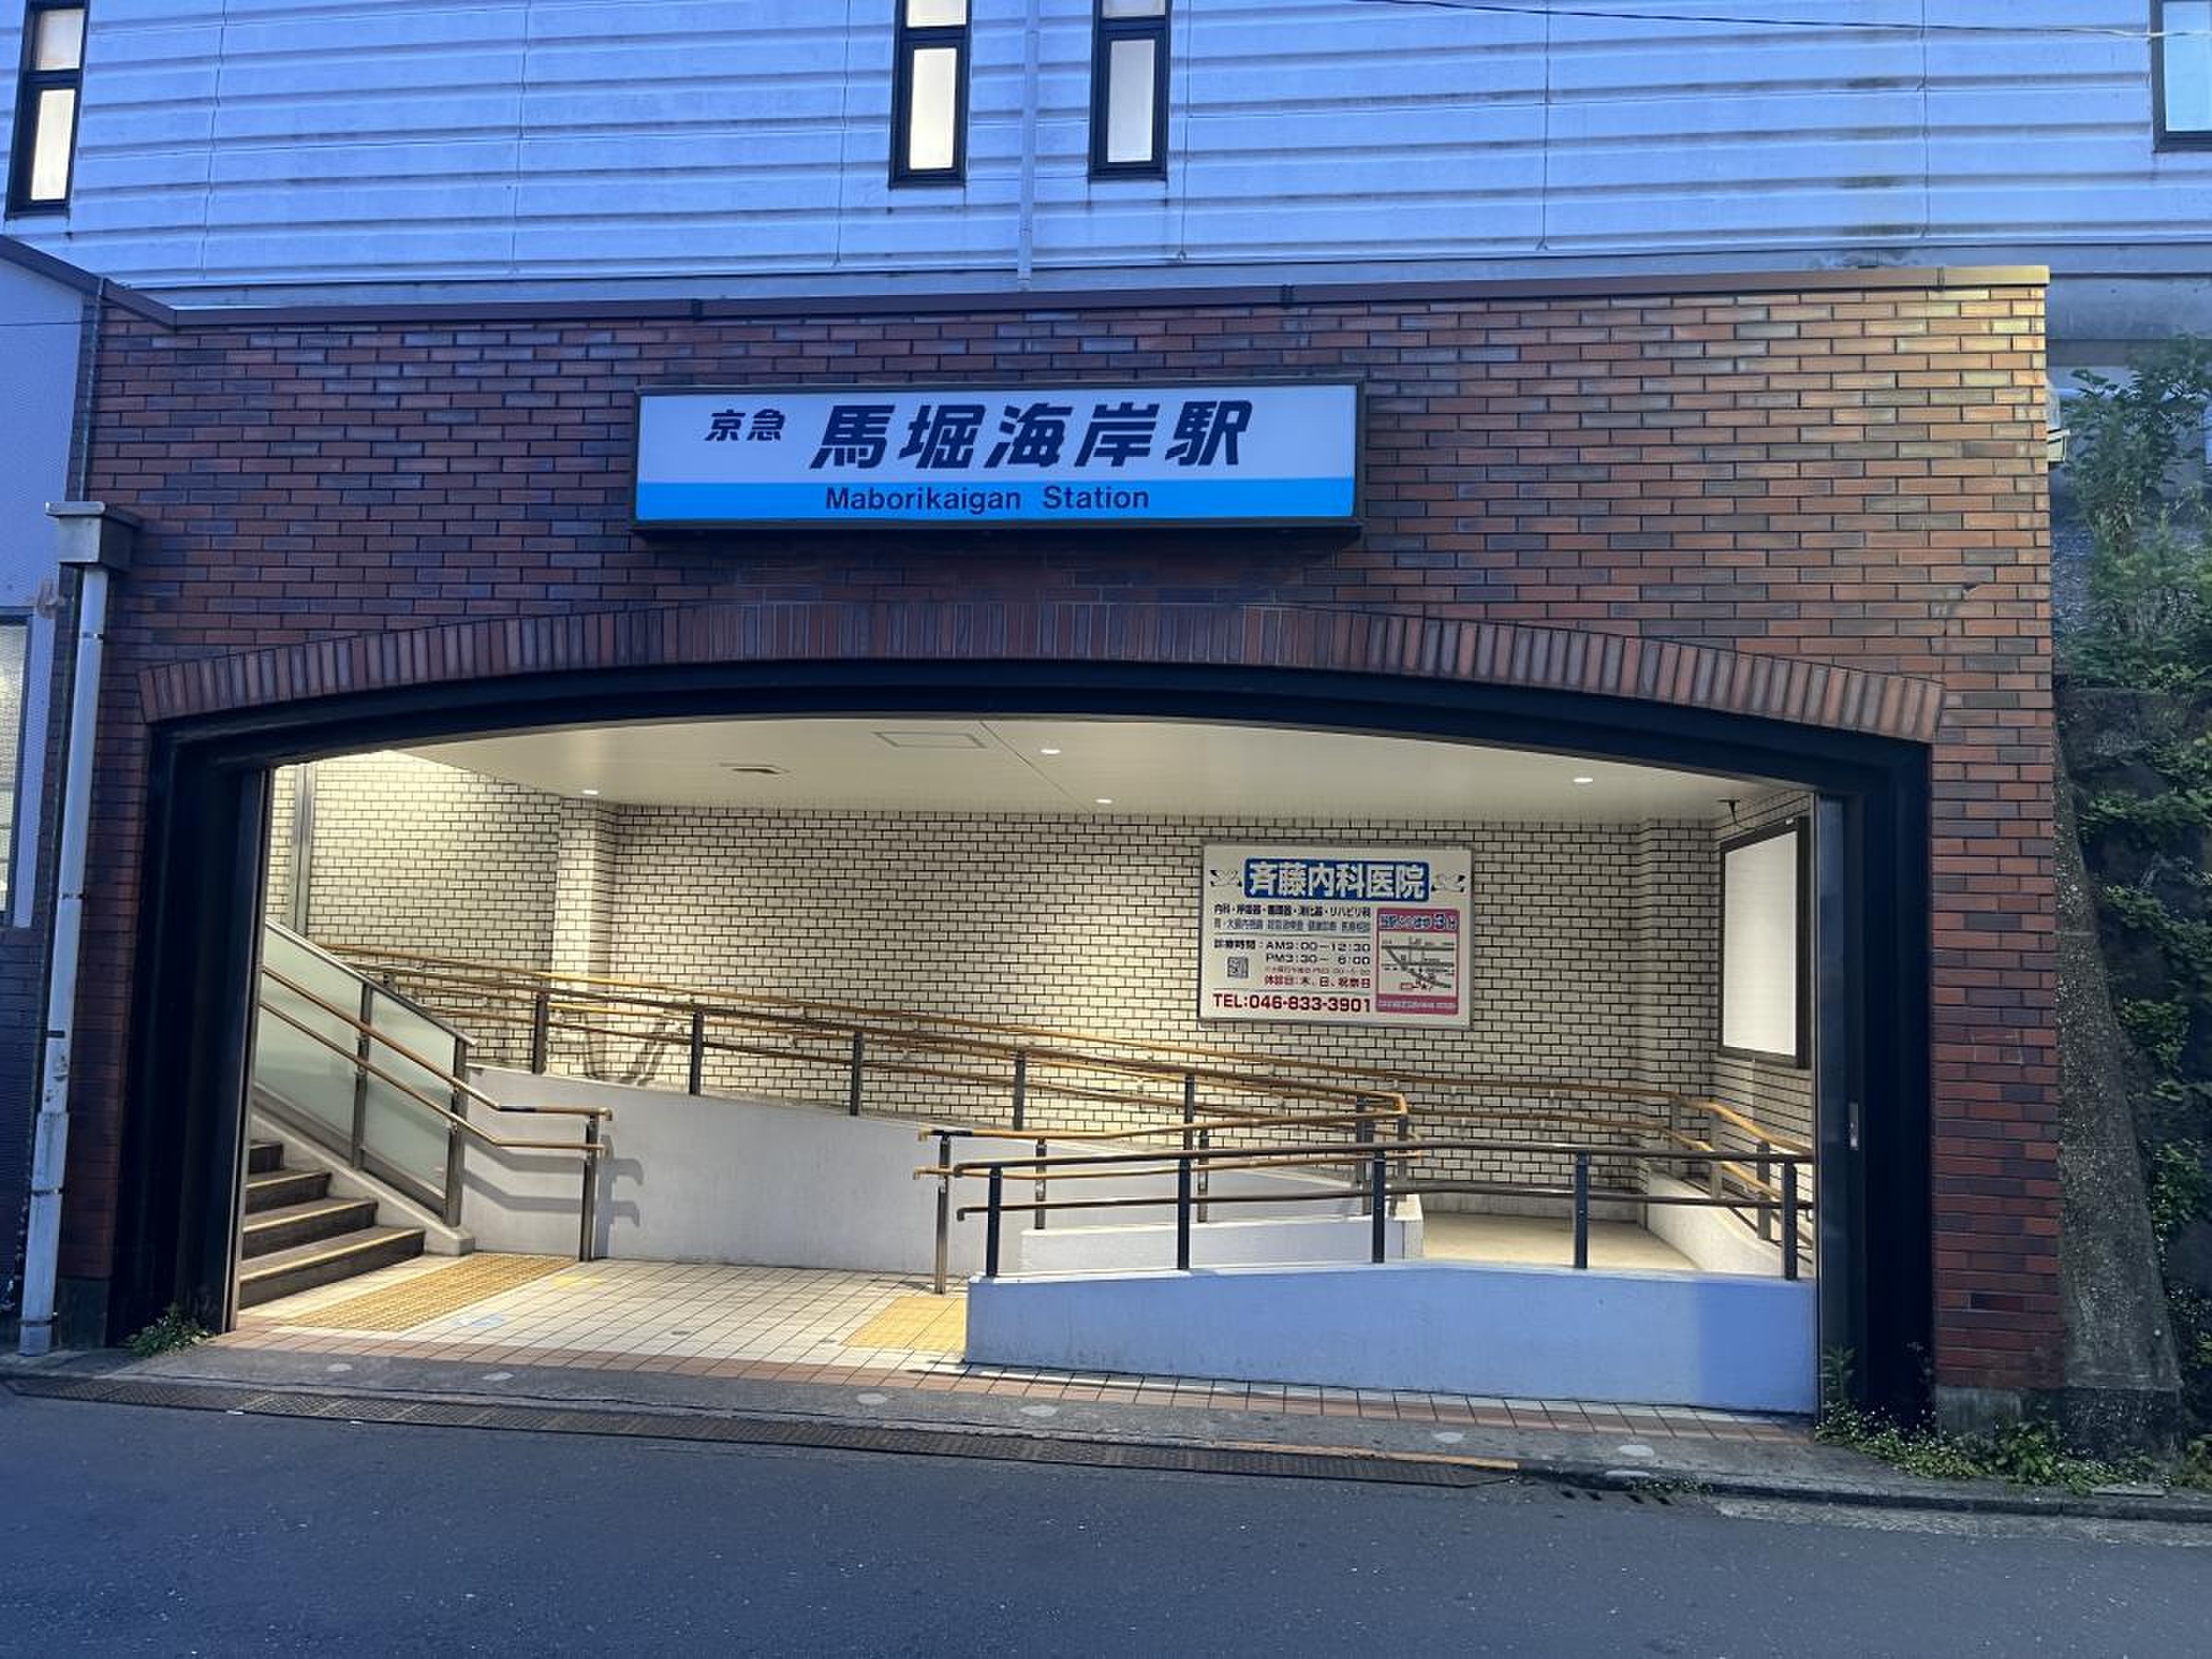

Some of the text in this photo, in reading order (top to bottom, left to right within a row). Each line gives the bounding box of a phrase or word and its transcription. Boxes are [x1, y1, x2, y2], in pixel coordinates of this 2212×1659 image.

[703, 398, 1253, 470] 京急 馬堀海岸駅
[825, 485, 1150, 516] Maborikaigan Station
